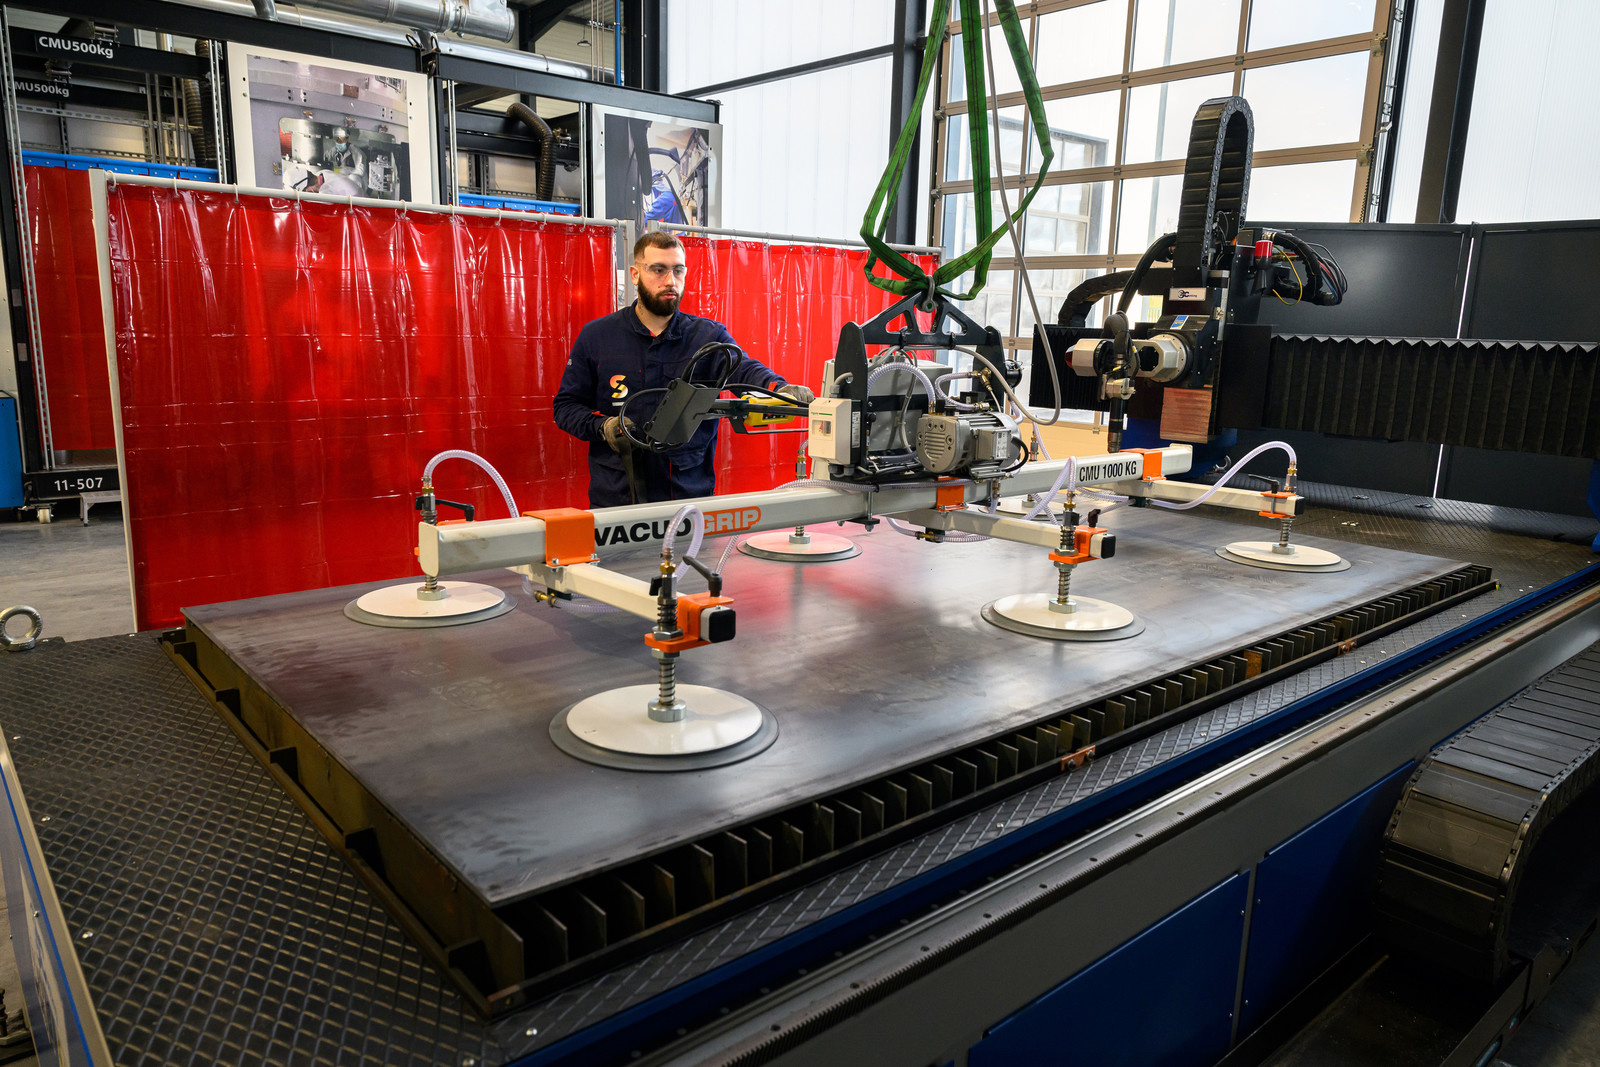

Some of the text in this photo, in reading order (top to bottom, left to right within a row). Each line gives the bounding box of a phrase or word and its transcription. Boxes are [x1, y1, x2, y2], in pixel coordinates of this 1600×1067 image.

[38, 35, 114, 59] CMU500kg
[12, 80, 70, 98] MU500kg
[1079, 460, 1137, 482] CMU 1000 KG
[54, 477, 103, 492] 11-507
